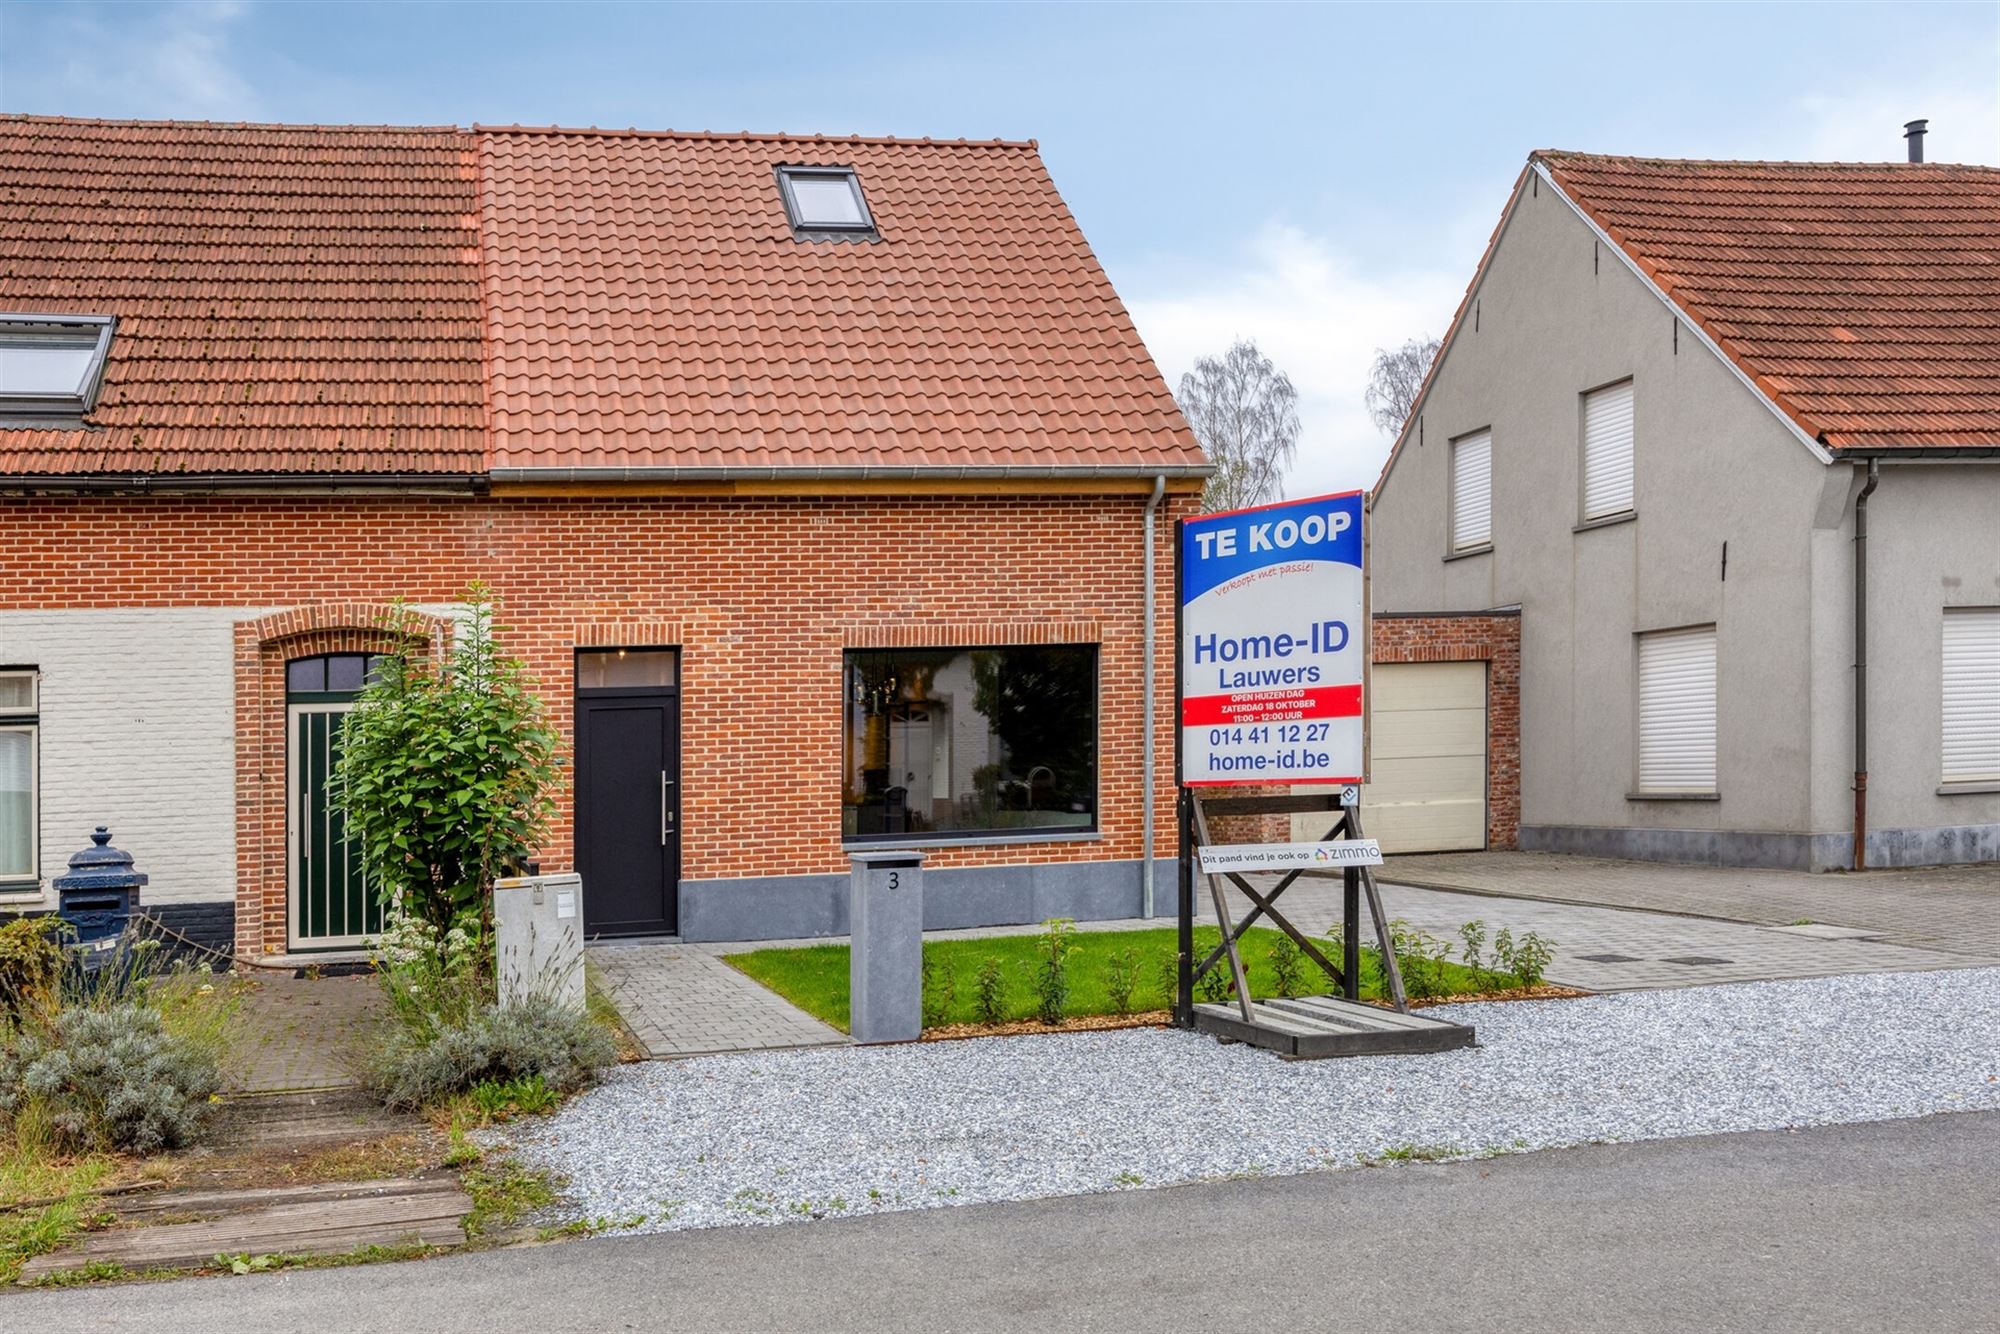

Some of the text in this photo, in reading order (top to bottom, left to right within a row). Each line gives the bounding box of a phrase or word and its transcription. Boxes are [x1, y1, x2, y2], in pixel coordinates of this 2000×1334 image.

[1195, 511, 1352, 560] TE KOOP
[1258, 567, 1277, 579] met
[1279, 561, 1314, 578] passie!
[1195, 620, 1349, 664] Home-ID
[1219, 665, 1320, 689] Lauwers
[1231, 689, 1305, 702] OPEN HUIZEN DAG
[1221, 699, 1316, 713] ZATERDAG 18 OKTOBER
[1233, 714, 1254, 723] 11:00
[1261, 712, 1283, 721] 12:00
[1284, 711, 1303, 719] UUR
[1209, 723, 1330, 746] 014 41 12 27
[1209, 749, 1330, 771] home-id.be
[1202, 855, 1216, 864] Dit
[1219, 855, 1242, 865] pand
[1244, 853, 1264, 862] vind
[1266, 853, 1275, 862] je
[1278, 852, 1295, 860] ook
[1297, 853, 1310, 861] op
[888, 872, 899, 890] 3
